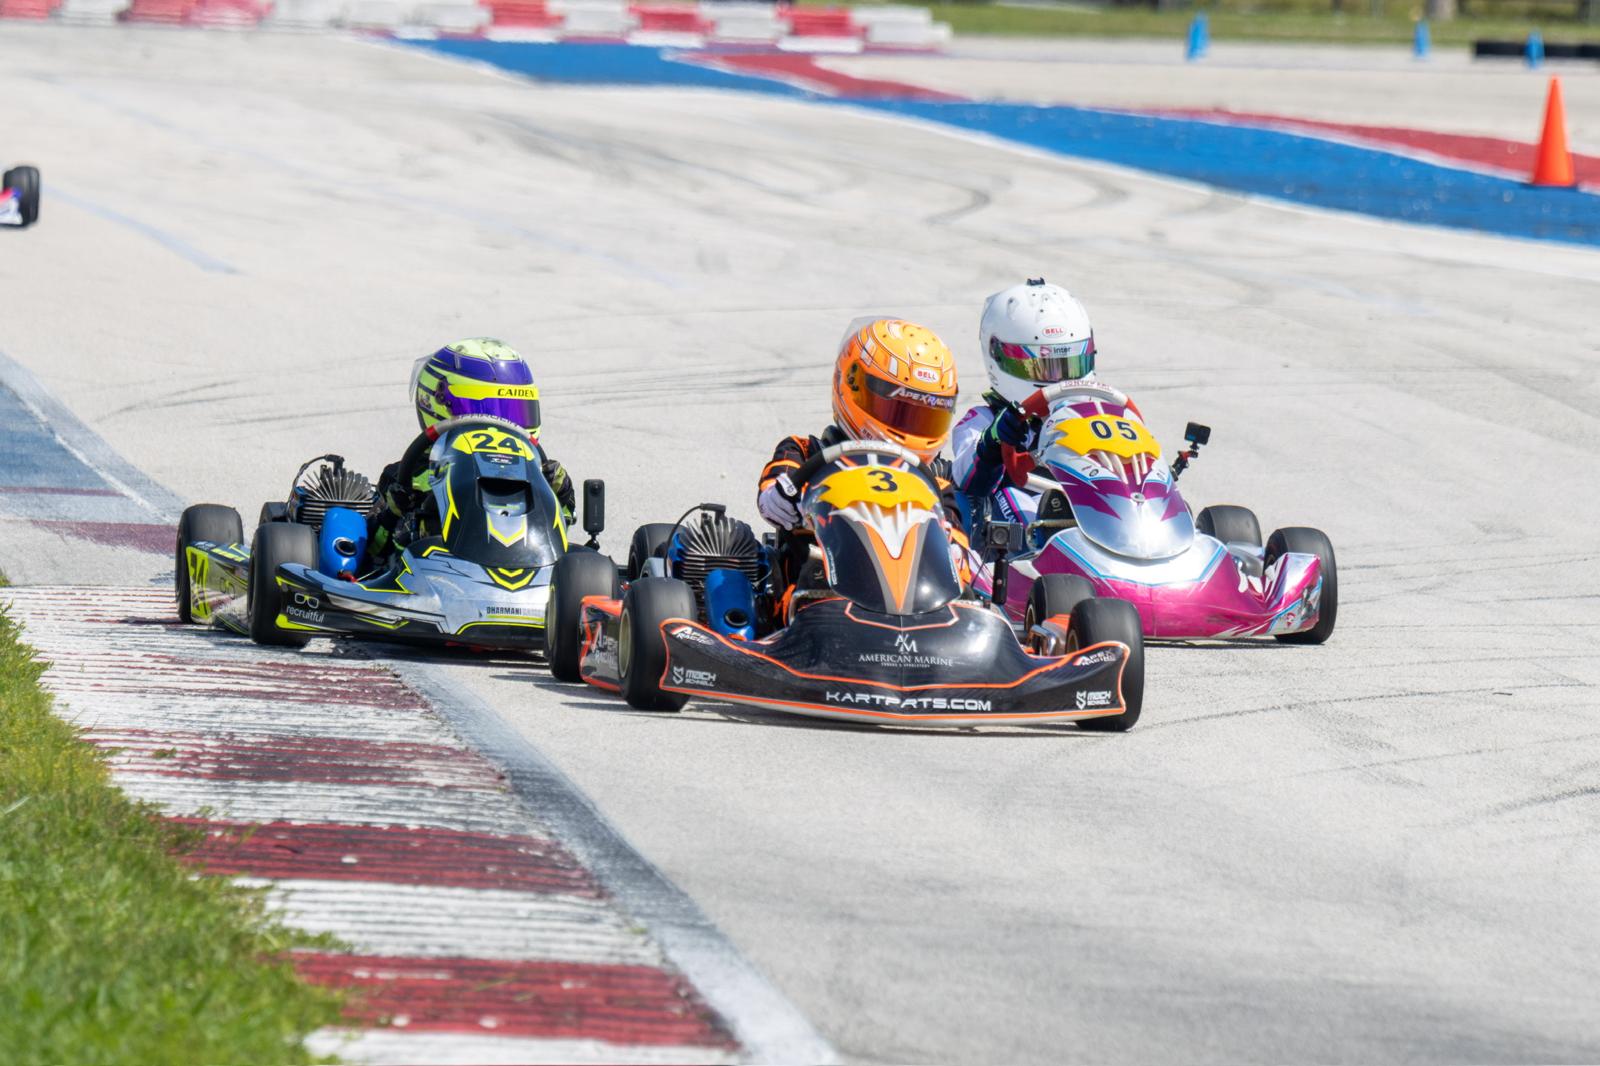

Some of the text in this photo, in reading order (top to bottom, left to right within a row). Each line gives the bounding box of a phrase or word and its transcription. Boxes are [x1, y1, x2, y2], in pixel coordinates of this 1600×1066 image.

[917, 370, 936, 380] BELL
[497, 388, 535, 398] CAIDEN
[1091, 420, 1138, 441] 05
[471, 432, 523, 454] 24
[867, 470, 898, 492] 3
[286, 605, 325, 623] recruitful
[486, 606, 522, 615] DHARMANI
[858, 653, 912, 663] AMERICAN
[914, 655, 954, 667] MARINE
[825, 691, 992, 712] KARTPARTS.COM
